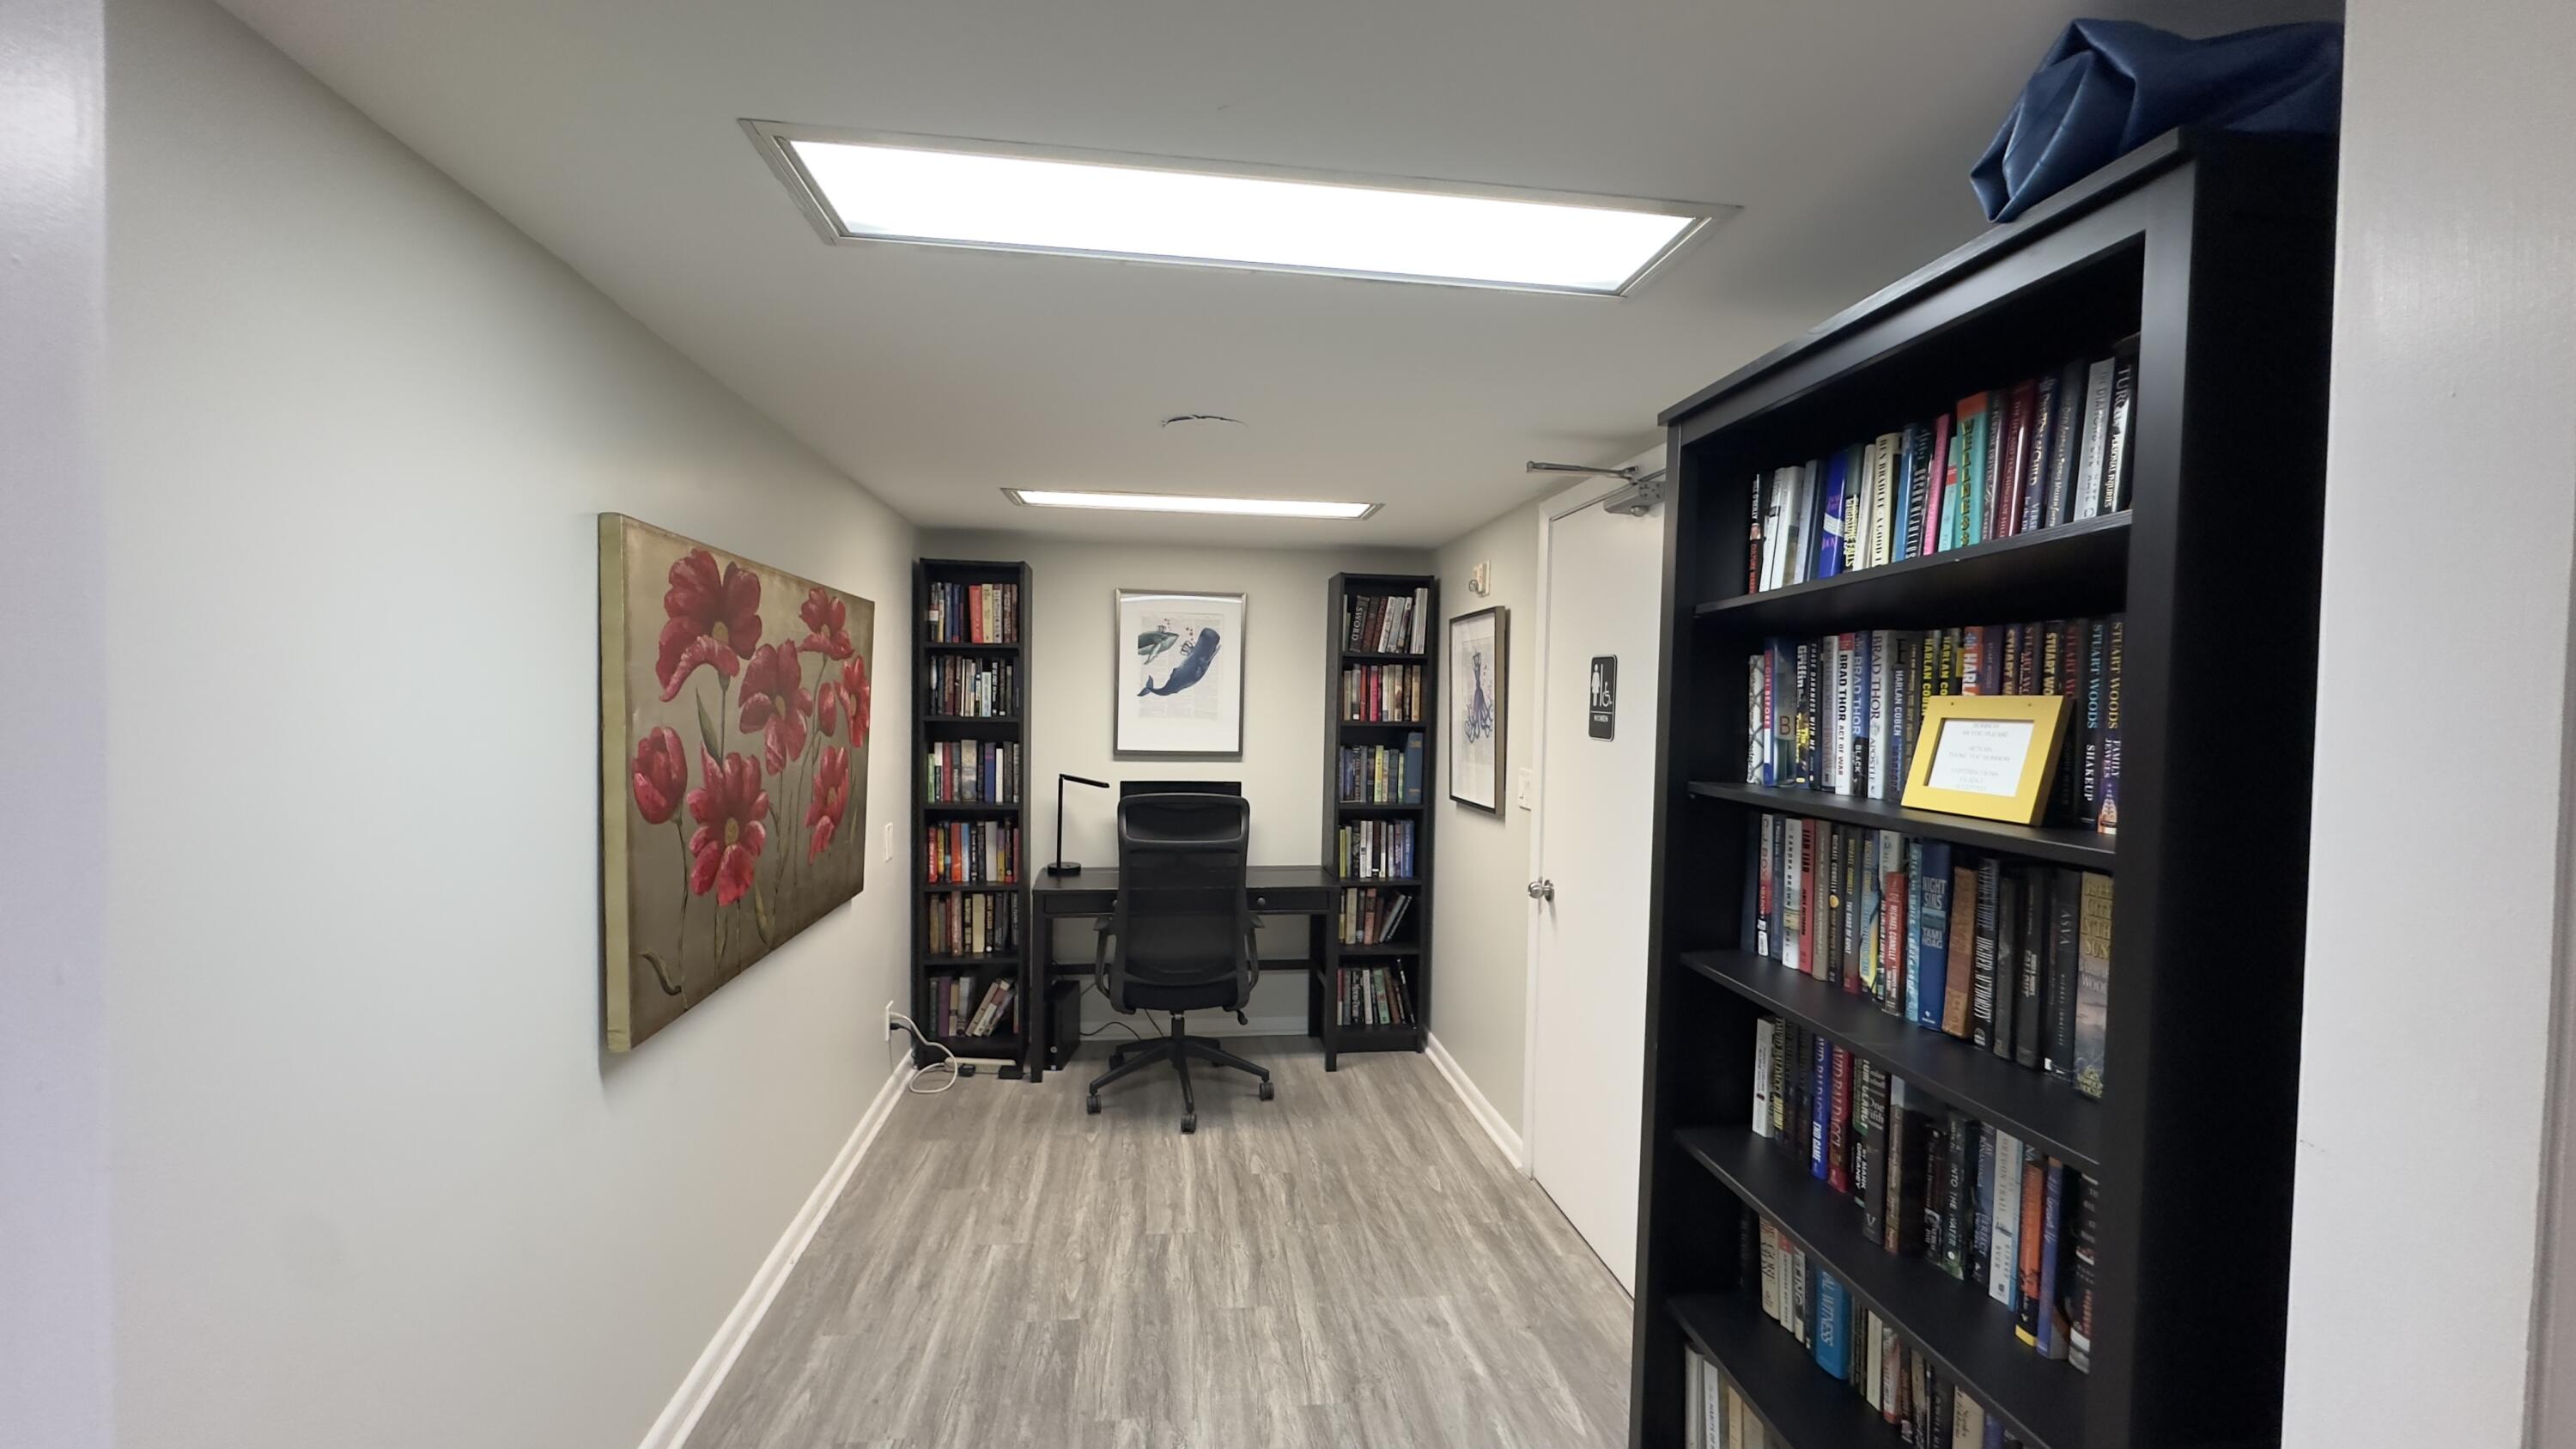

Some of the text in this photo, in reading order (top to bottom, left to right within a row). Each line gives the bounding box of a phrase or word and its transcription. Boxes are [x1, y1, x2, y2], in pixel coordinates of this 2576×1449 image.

[1990, 411, 1999, 447] PURPOSE
[1877, 439, 1887, 508] BEN BRADLEE
[1911, 468, 1926, 503] OSCAR
[1960, 418, 1976, 547] WELLNESS
[1987, 448, 1997, 481] DRIVEN
[2003, 456, 2016, 502] TEACHINGS
[2029, 450, 2041, 486] CHILD
[2104, 433, 2120, 508] PERSONAL INJURIES
[2002, 503, 2008, 514] OF
[1905, 506, 1922, 560] HIJUELOS
[1845, 543, 1856, 568] FALLS
[1352, 606, 1363, 642] SWORD
[1796, 645, 1807, 689] Griffin
[1923, 638, 1933, 680] HARLAN
[1941, 636, 1952, 679] HARLAN
[2004, 629, 2016, 679] STUART
[2023, 626, 2035, 675] STUART
[2044, 632, 2058, 675] STUART
[2064, 624, 2076, 673] STUART
[1838, 654, 1848, 687] BRAD
[1870, 636, 1881, 720] BRAD THOR
[2087, 624, 2103, 729] STUART WOODS
[2107, 621, 2123, 729] STUART WOODS
[1838, 689, 1847, 721] THOR
[1851, 656, 1862, 735] BRAD THOR
[1893, 670, 1904, 737] HARLAN COBEN
[1808, 740, 1816, 752] ME
[1838, 744, 1844, 753] OF
[1854, 744, 1862, 773] BLACK
[2104, 737, 2112, 779] JEWELS
[2111, 740, 2122, 779] FAMILY
[2083, 744, 2096, 802] SHAKEUP
[1830, 861, 1838, 893] CONNELLY
[1922, 876, 1947, 894] NIGHT
[1923, 892, 1942, 910] SINS
[1887, 904, 1898, 961] MICHAEL CONNELLY
[1922, 926, 1942, 940] TAMI
[1922, 936, 1944, 949] HOAG
[1973, 935, 1994, 1023] HIGHER AUTHORITY
[1814, 1035, 1826, 1063] AVID
[1773, 1048, 1784, 1096] BALDACCI
[1829, 1044, 1844, 1148] AVID BALDACCI
[1811, 1121, 1822, 1163] END GAME
[1854, 1142, 1862, 1190] GREANEY
[1949, 1162, 1959, 1188] INTO
[1997, 1137, 2011, 1214] OREGON TRAIL
[1948, 1190, 1959, 1210] THE
[1947, 1213, 1959, 1248] WATER
[1994, 1244, 2002, 1271] BUCK
[2002, 1244, 2012, 1282] RINKER
[1820, 1293, 1836, 1348] WITNESS
